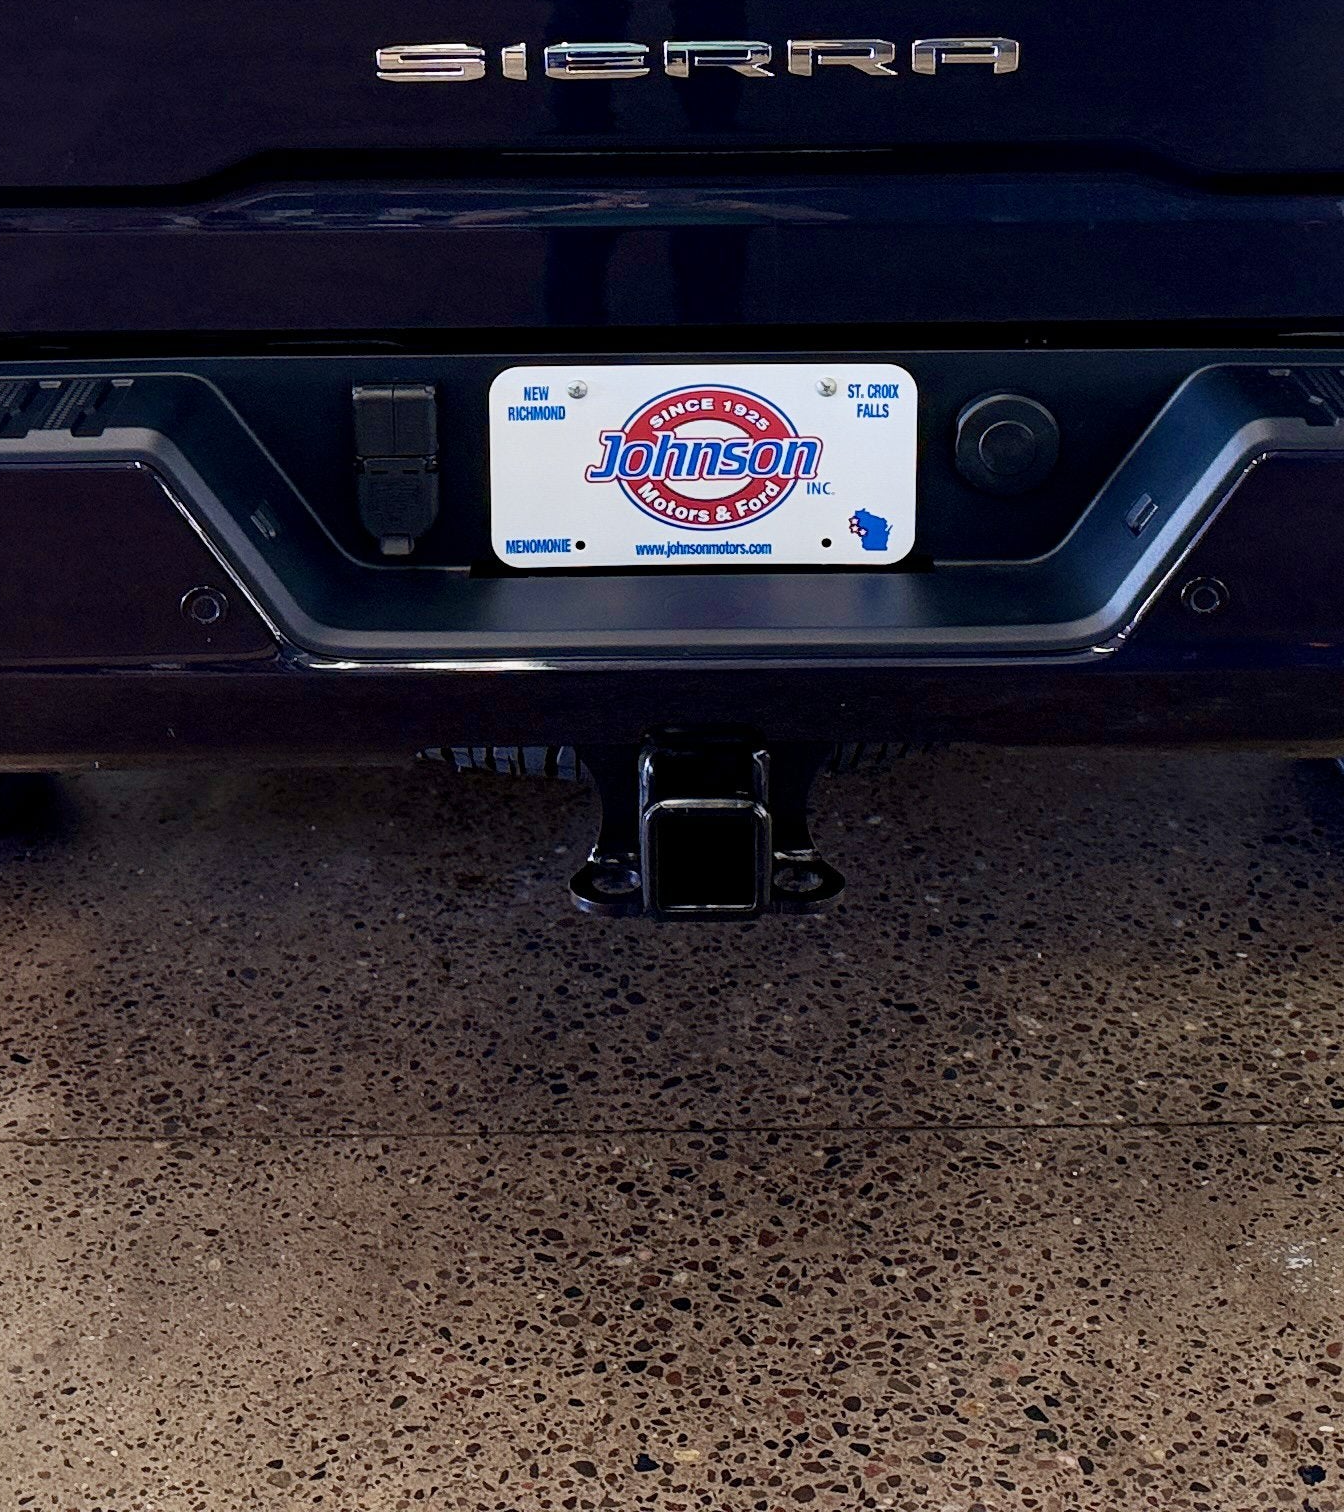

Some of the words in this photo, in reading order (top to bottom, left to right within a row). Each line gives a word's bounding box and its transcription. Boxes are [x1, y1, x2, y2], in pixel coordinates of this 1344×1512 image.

[375, 37, 1020, 81] SIERRA
[523, 386, 549, 402] NEW
[847, 383, 865, 399] ST.
[867, 383, 900, 399] CROIX
[508, 405, 566, 422] RICHMOND
[648, 397, 715, 429] SINCE
[722, 399, 772, 432] 1925
[856, 403, 890, 418] FALLS
[588, 433, 820, 479] Johnson
[637, 481, 711, 524] Motors
[714, 505, 734, 523] &
[734, 479, 782, 518] Ford
[505, 538, 572, 555] MENOMONIE
[634, 540, 773, 558] www.johnsonmotors.com
